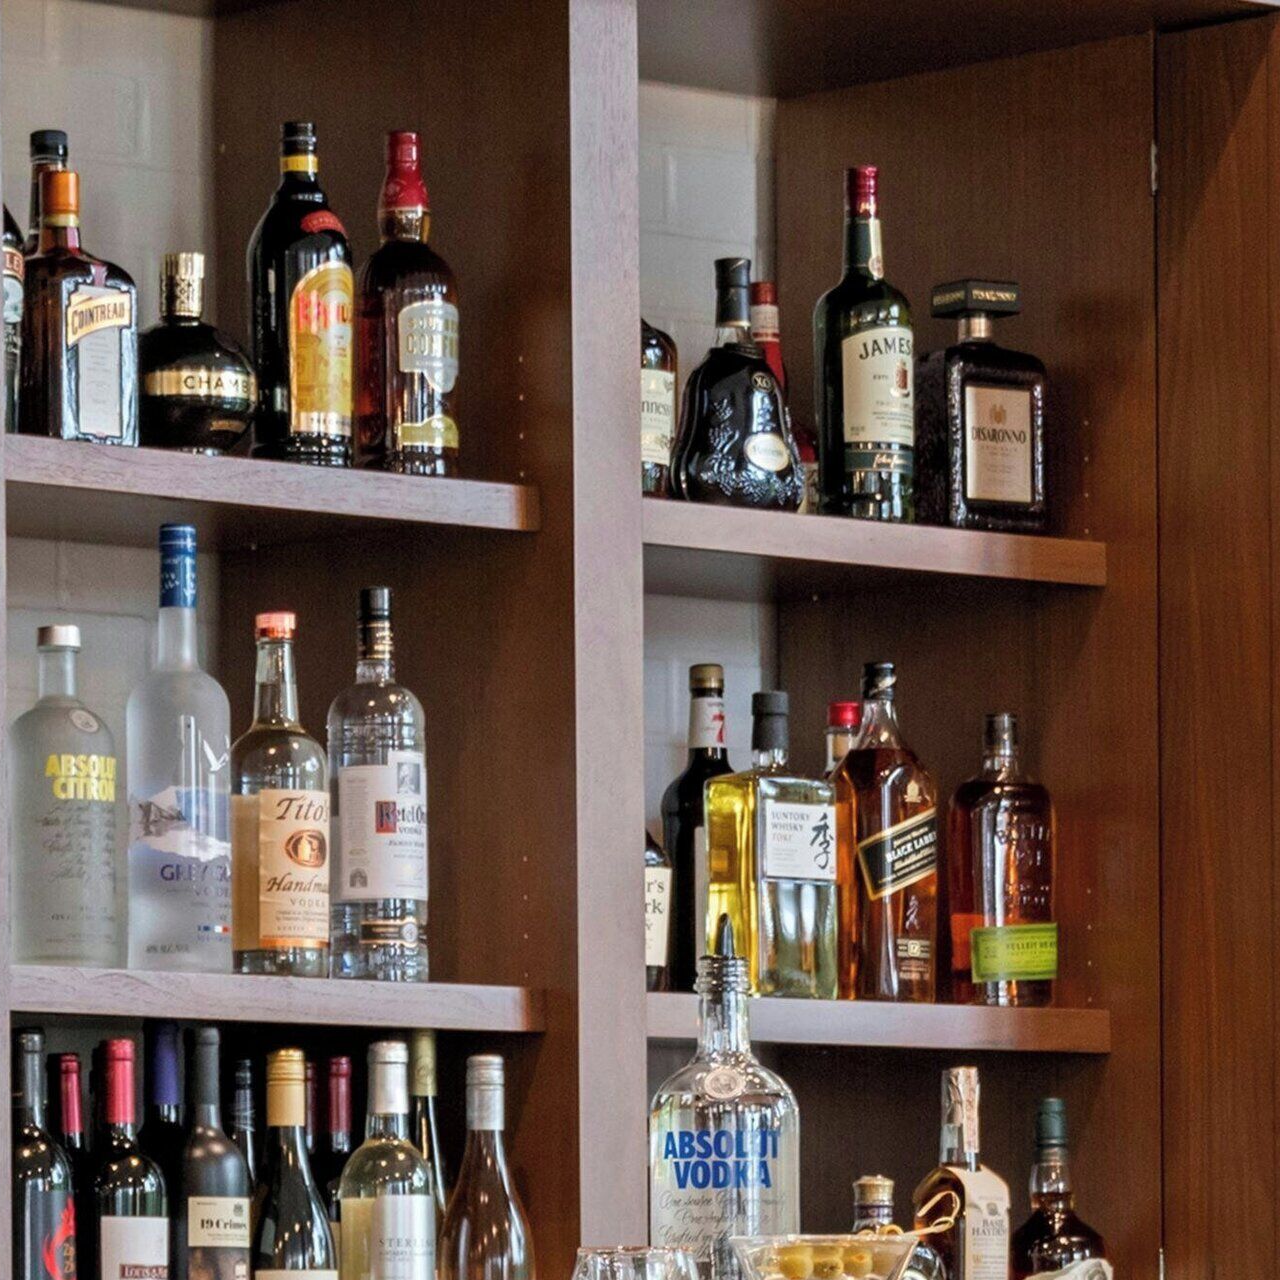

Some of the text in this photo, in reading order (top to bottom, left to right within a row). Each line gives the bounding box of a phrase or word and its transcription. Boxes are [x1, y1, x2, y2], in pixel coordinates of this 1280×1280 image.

[71, 302, 126, 336] COINTREAU
[972, 425, 1026, 445] DISARONNO
[663, 1129, 781, 1160] ABSOLUT
[673, 1160, 773, 1189] VODKA
[201, 1218, 214, 1230] 19
